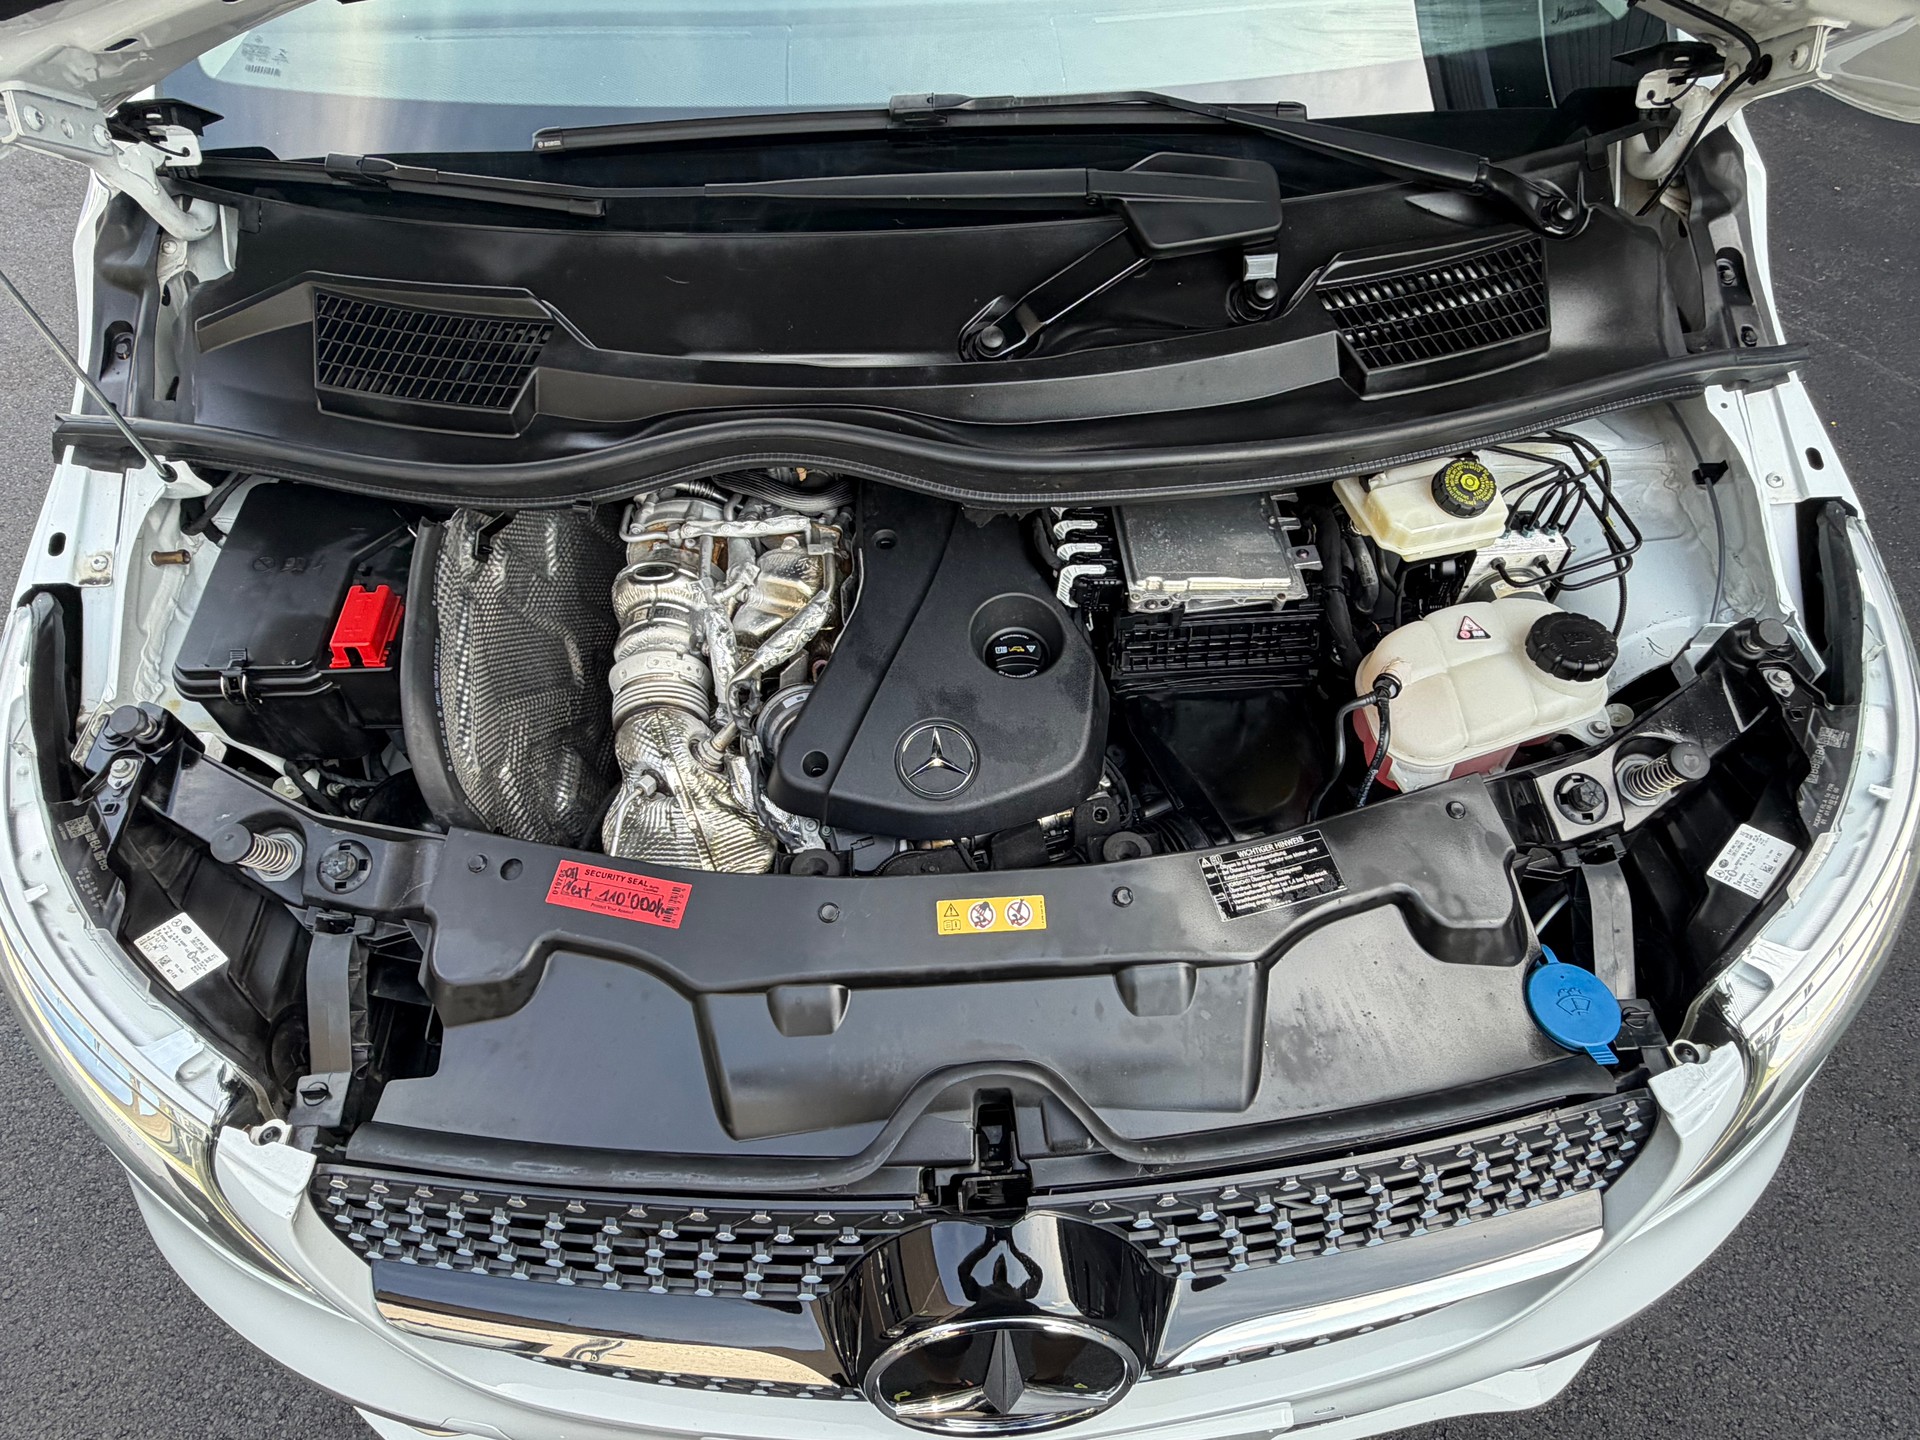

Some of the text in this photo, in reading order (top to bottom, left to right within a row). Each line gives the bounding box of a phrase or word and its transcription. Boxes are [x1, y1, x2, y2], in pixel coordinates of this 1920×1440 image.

[1236, 835, 1304, 858] WICHTIGER HINWEIS
[584, 868, 648, 888] SECURITY SEAL
